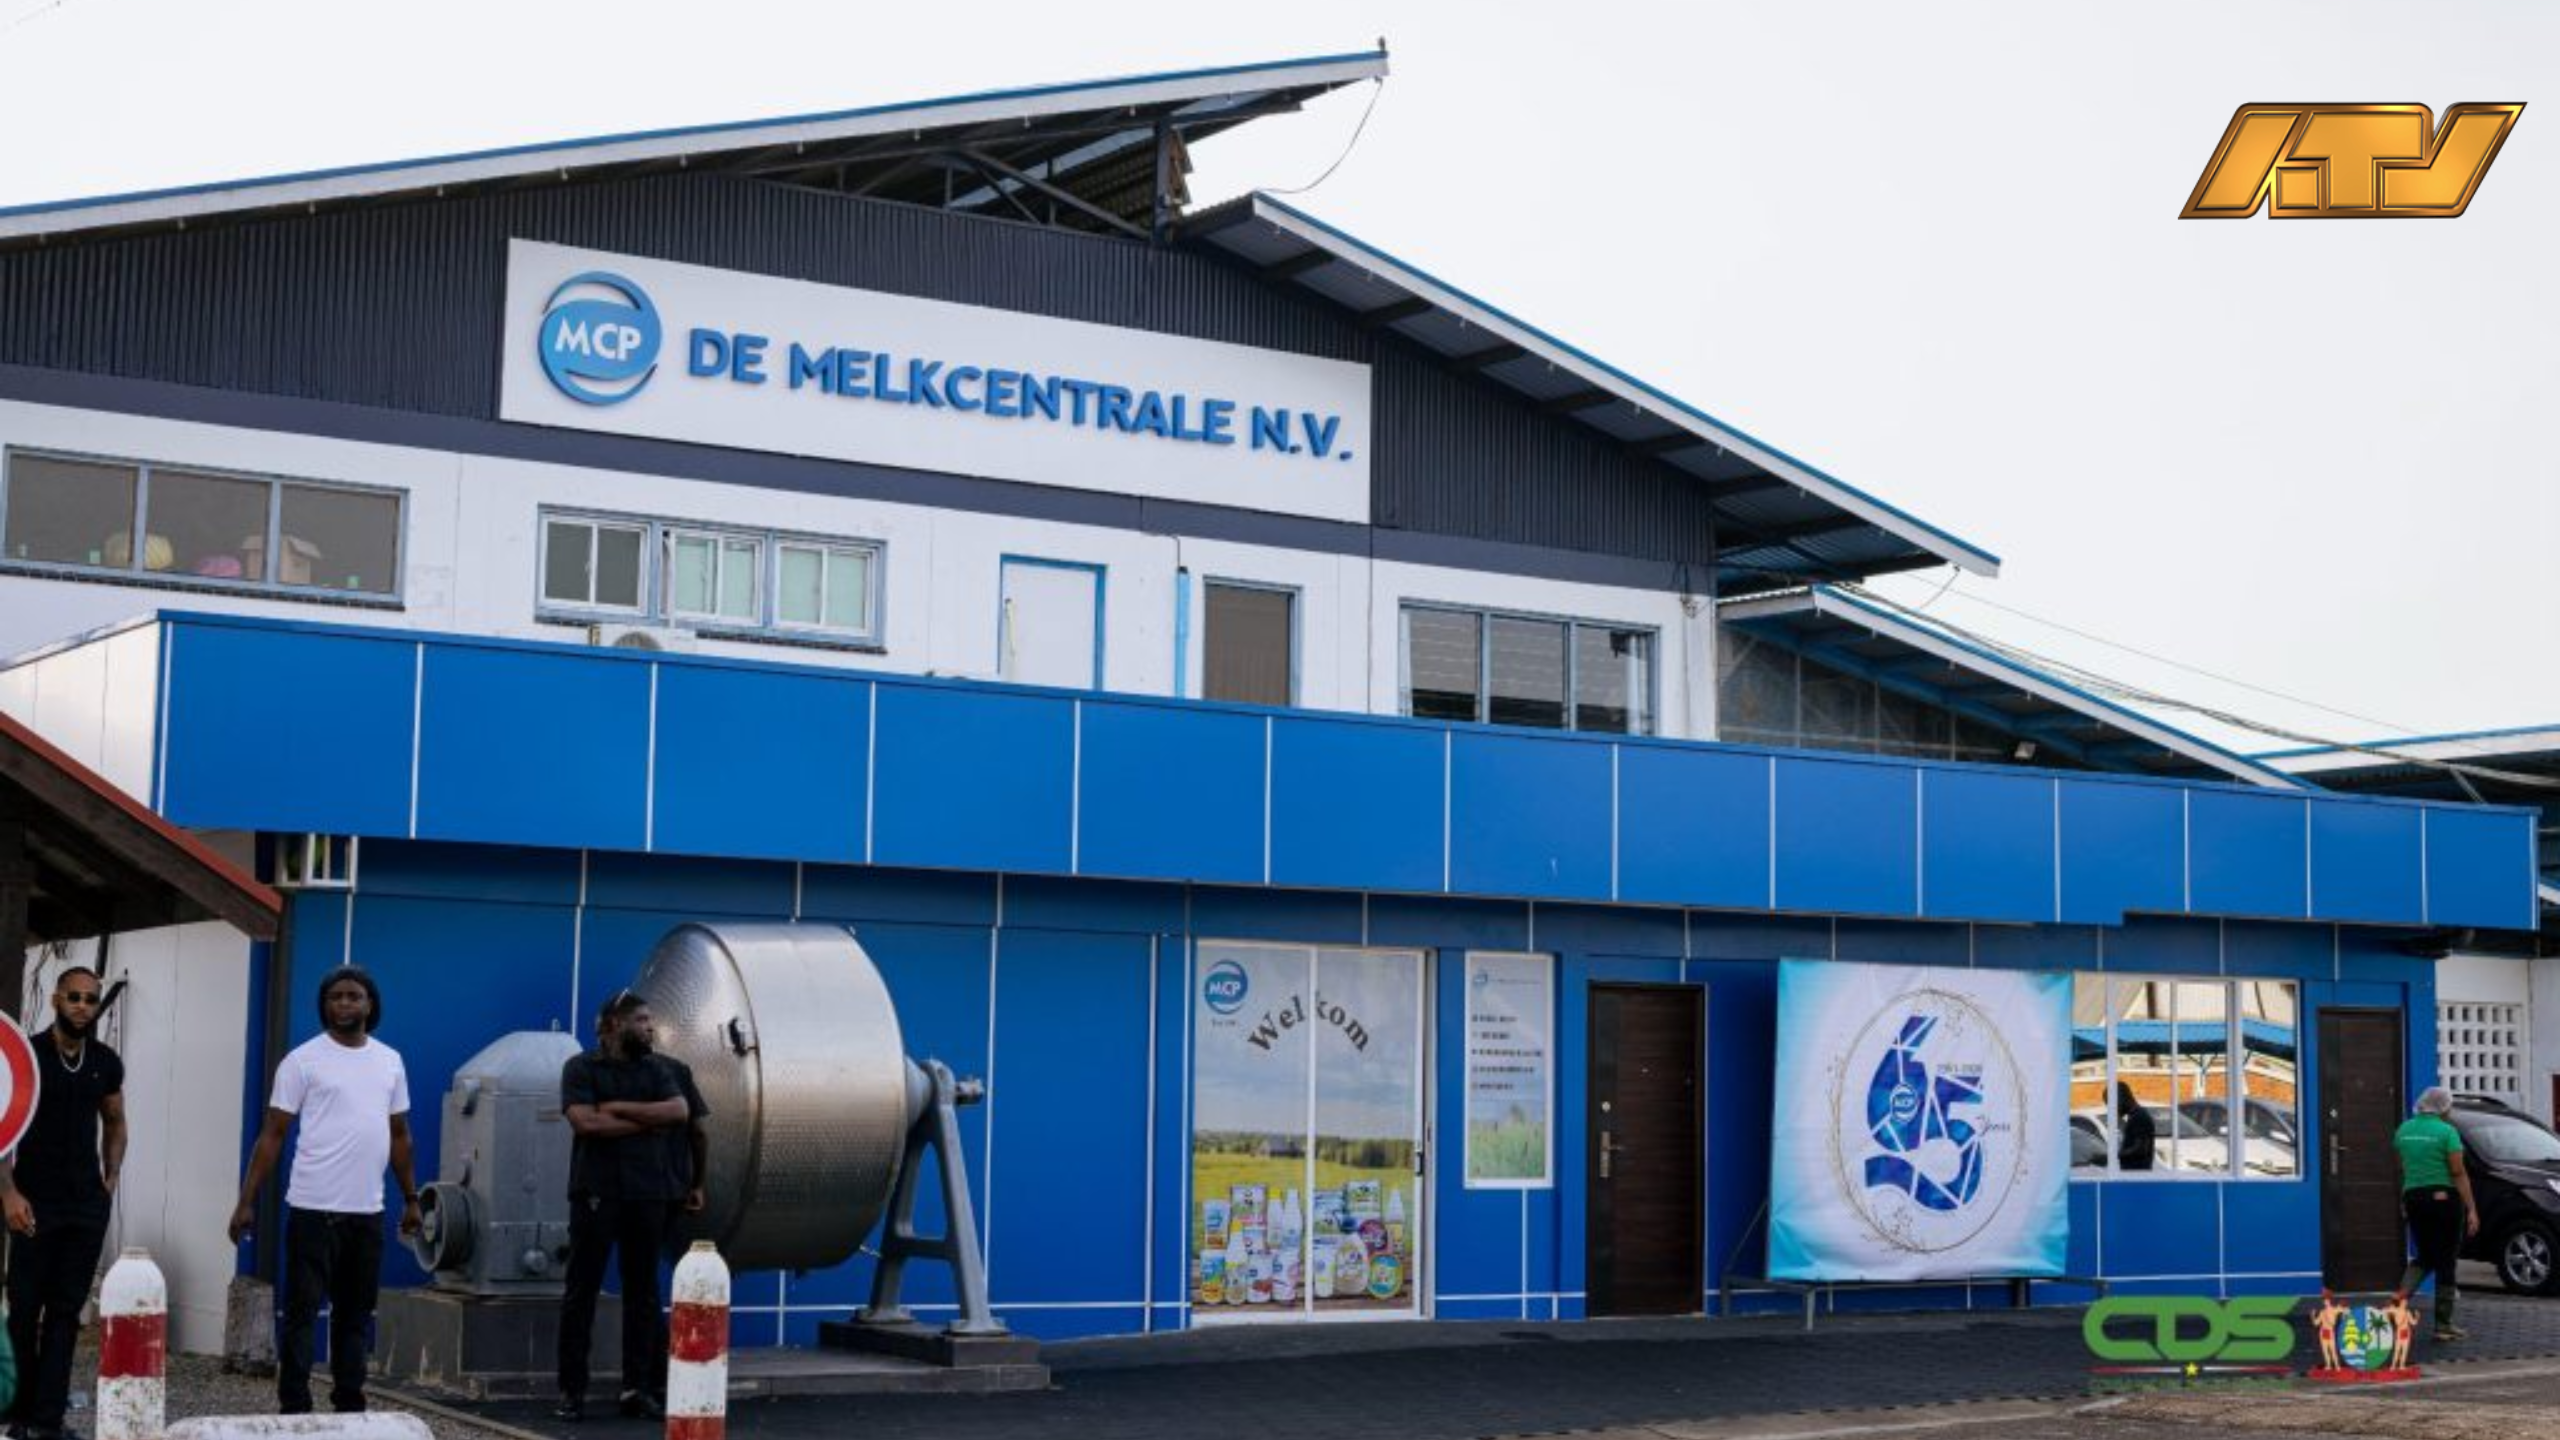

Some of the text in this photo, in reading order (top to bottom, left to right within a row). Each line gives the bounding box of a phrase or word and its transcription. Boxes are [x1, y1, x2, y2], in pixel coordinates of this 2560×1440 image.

[555, 317, 641, 371] MCP
[688, 328, 1354, 461] DE MELKCENTRALE N.V.
[1209, 981, 1241, 995] MCP
